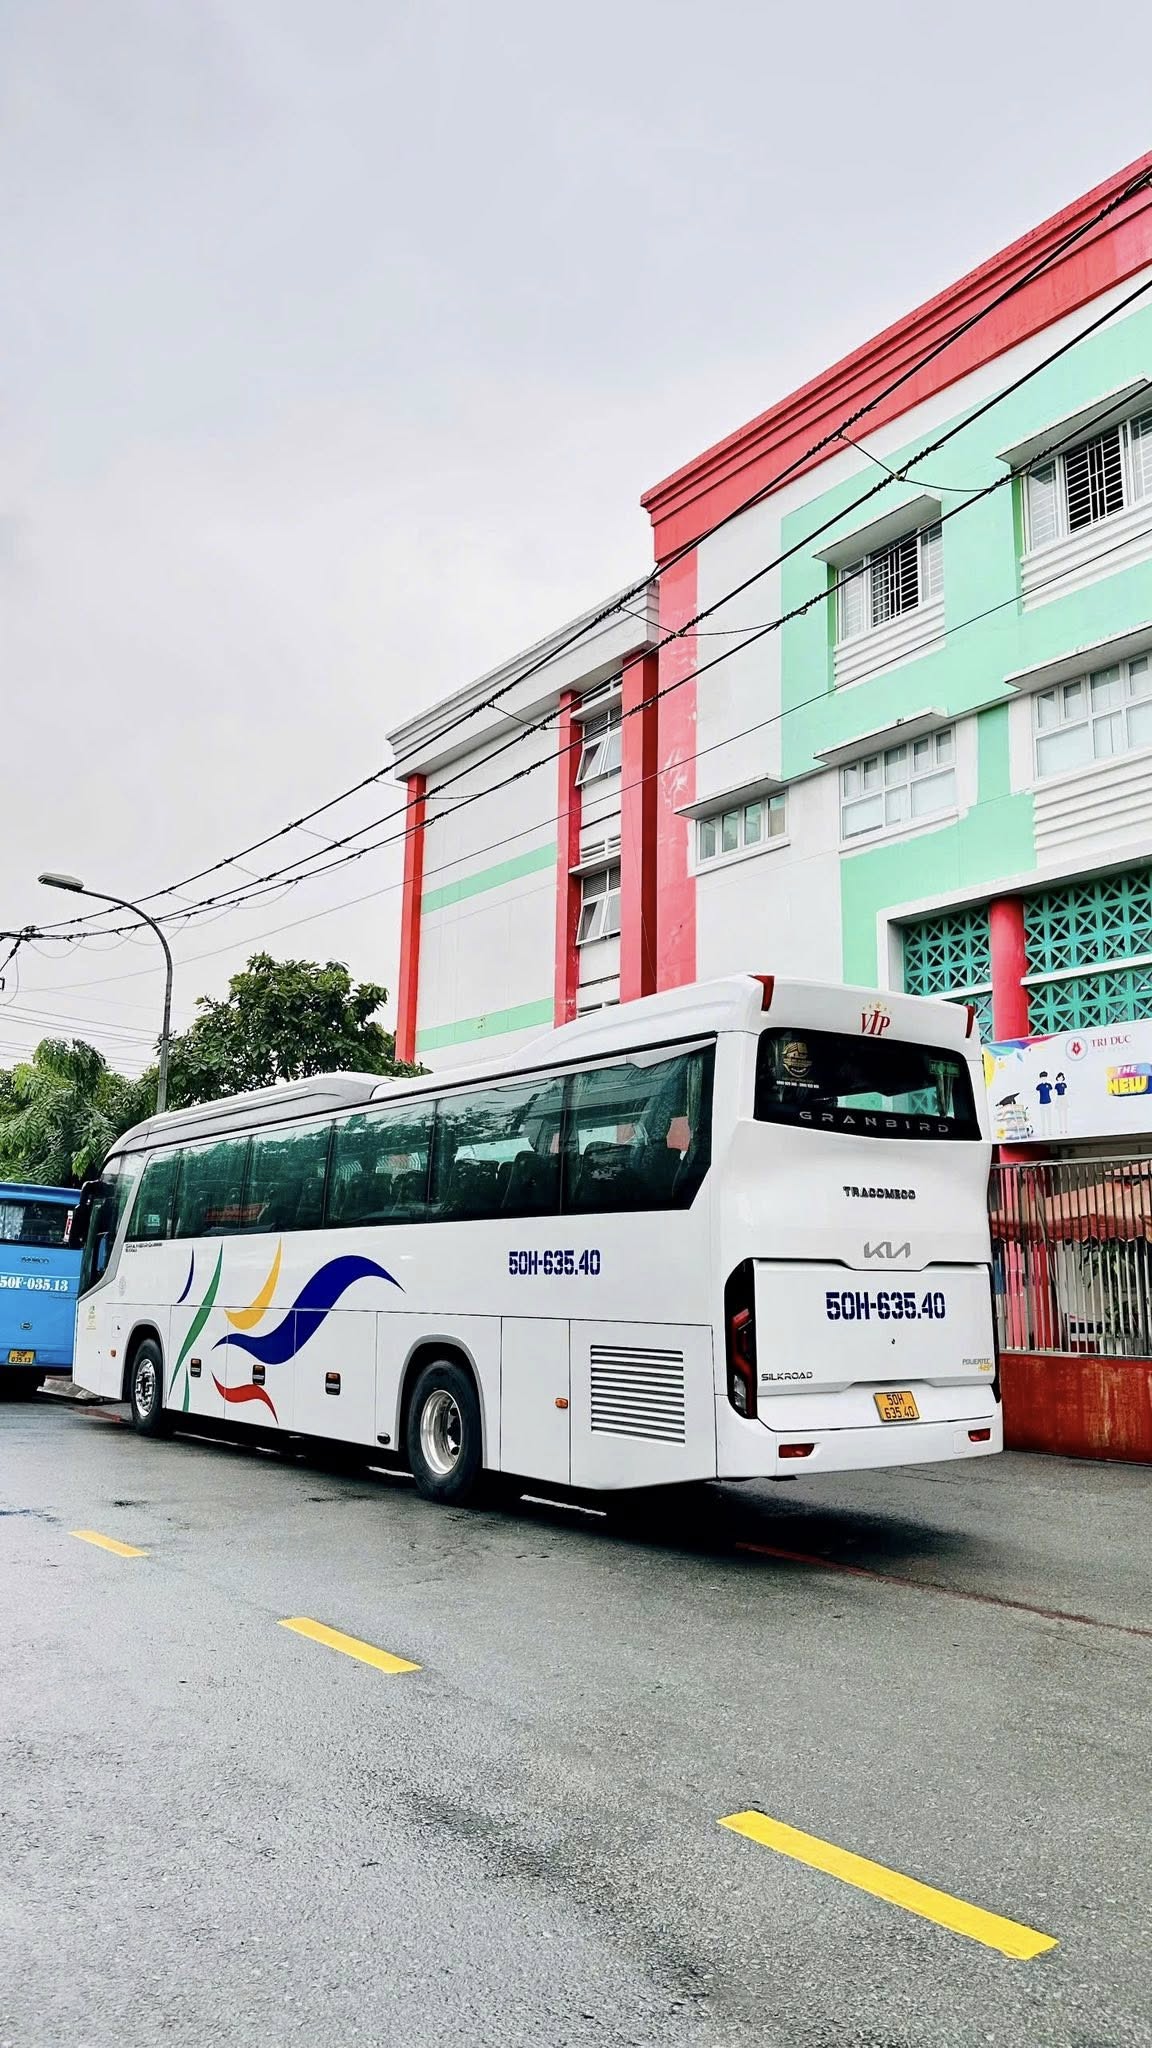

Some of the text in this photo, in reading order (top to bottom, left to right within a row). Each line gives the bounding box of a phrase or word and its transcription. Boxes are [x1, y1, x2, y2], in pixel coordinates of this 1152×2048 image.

[861, 1010, 891, 1036] VIP
[1117, 1065, 1137, 1074] THE
[1108, 1075, 1148, 1095] NEW
[799, 1111, 949, 1133] GRANBIRD
[843, 1186, 916, 1200] TRACOMECO
[863, 1241, 911, 1259] KIA
[508, 1249, 601, 1275] 50H-635.40
[0, 1275, 68, 1291] 50F-035.13
[825, 1291, 946, 1320] 50H-635.40
[761, 1371, 813, 1382] SILKROAD
[887, 1394, 905, 1406] 50H
[885, 1406, 915, 1419] 635.40
